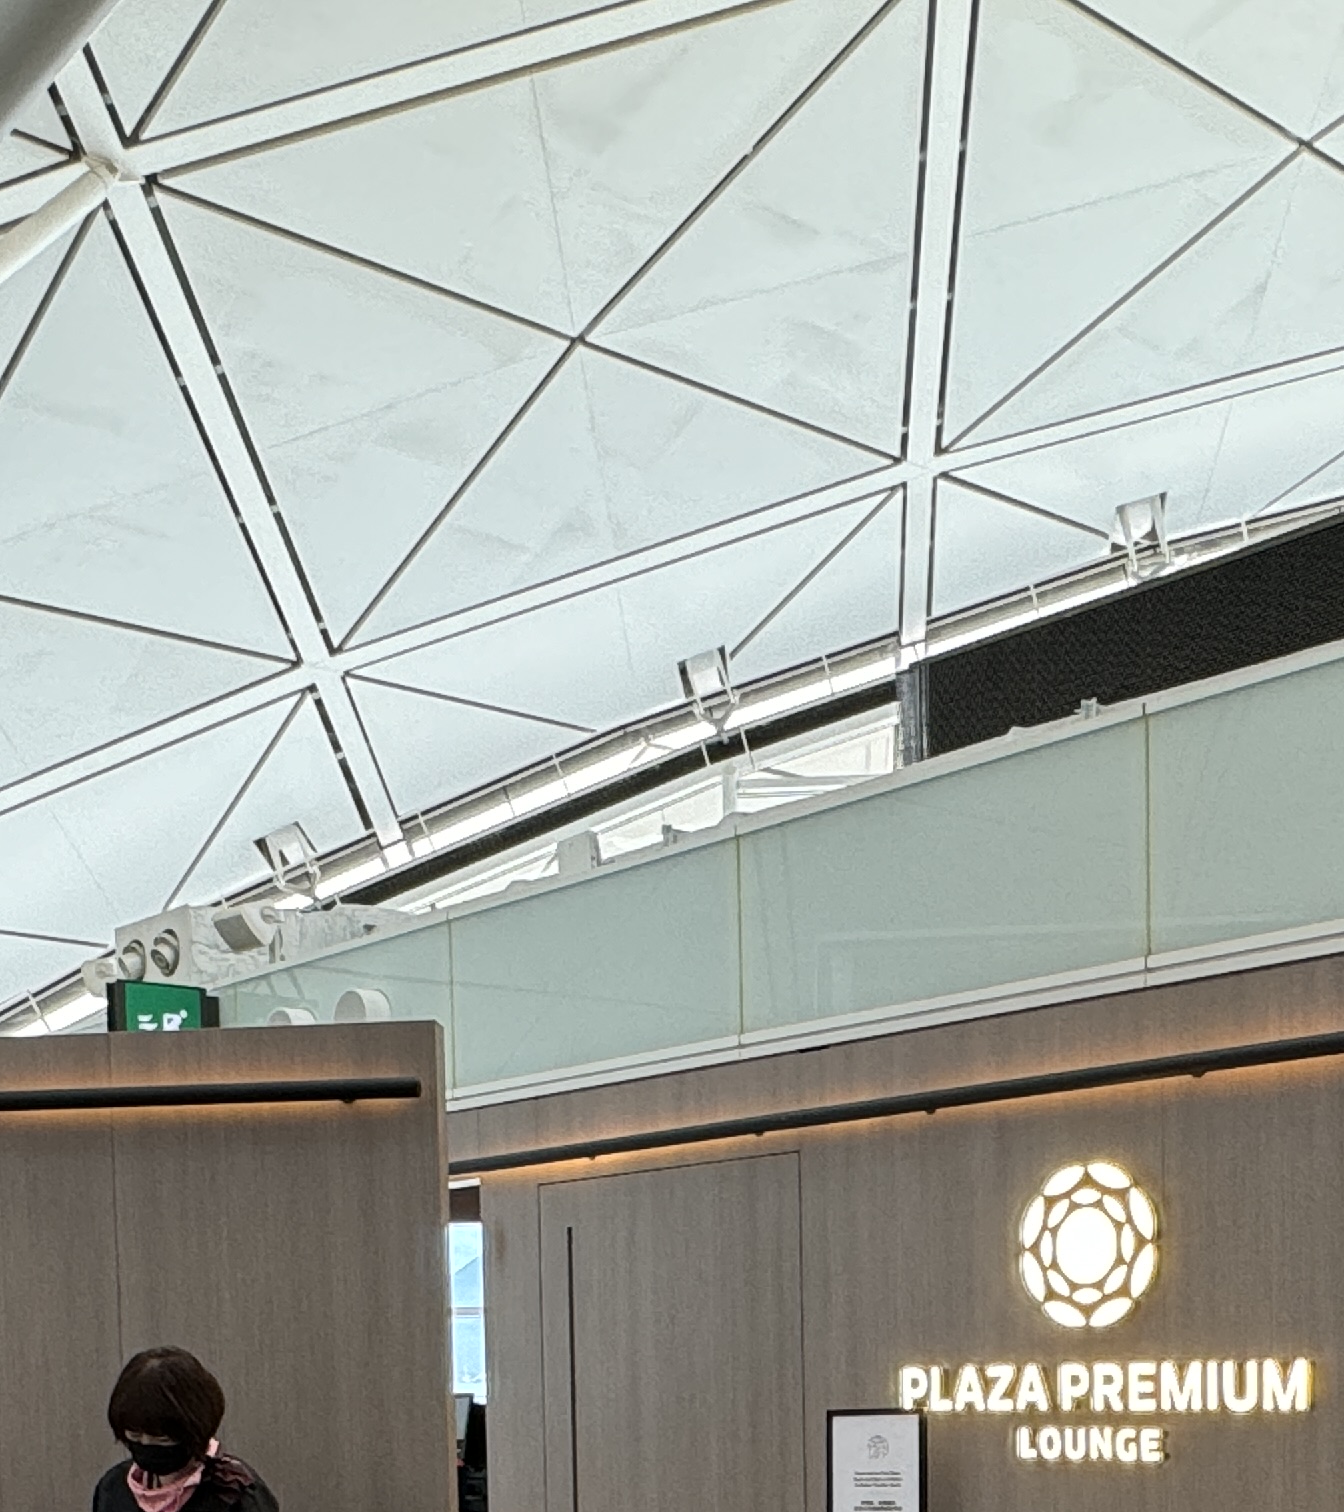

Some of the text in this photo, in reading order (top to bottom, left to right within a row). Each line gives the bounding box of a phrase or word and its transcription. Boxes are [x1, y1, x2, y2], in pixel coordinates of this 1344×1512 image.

[899, 1357, 1313, 1413] PLAZA PREMIUM
[1015, 1425, 1166, 1462] LOUNGE
